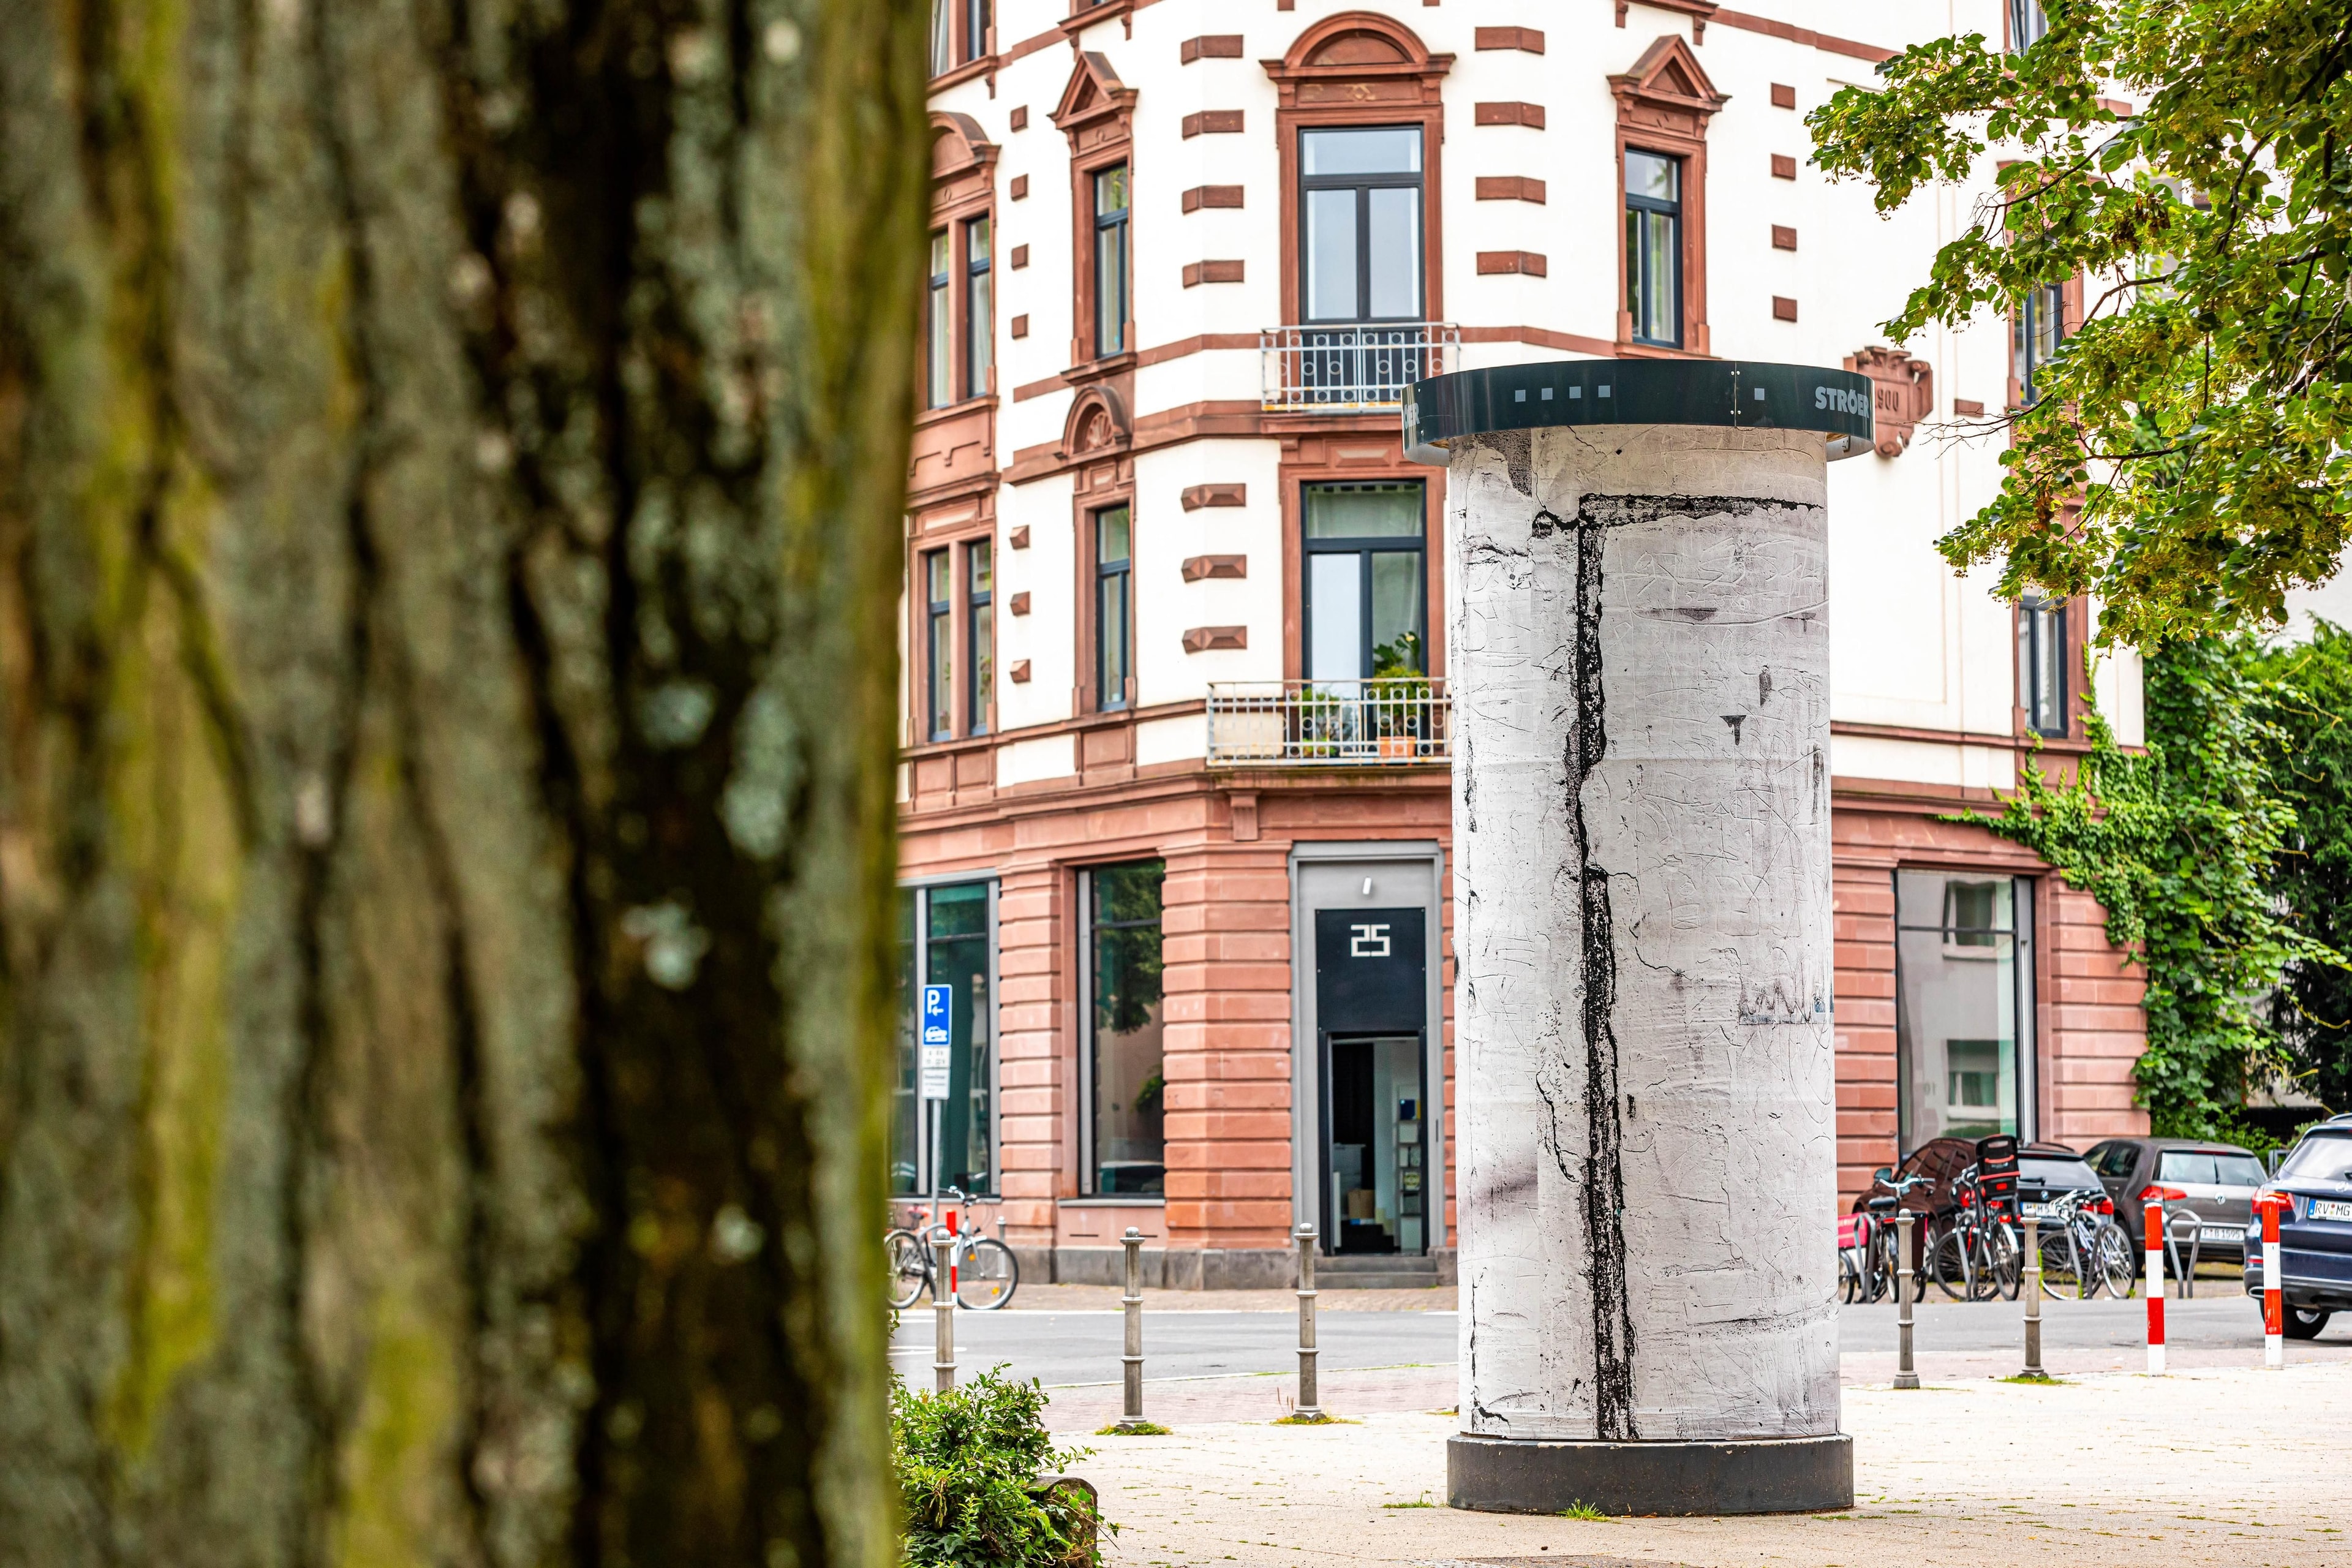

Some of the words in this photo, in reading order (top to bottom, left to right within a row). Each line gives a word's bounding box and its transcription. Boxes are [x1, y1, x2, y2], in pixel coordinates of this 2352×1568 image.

[1815, 386, 1869, 418] STRÖER
[1875, 389, 1899, 412] 900
[1351, 924, 1390, 957] 25
[927, 990, 940, 1014] P
[2315, 1202, 2329, 1215] RV
[2336, 1204, 2350, 1216] MG
